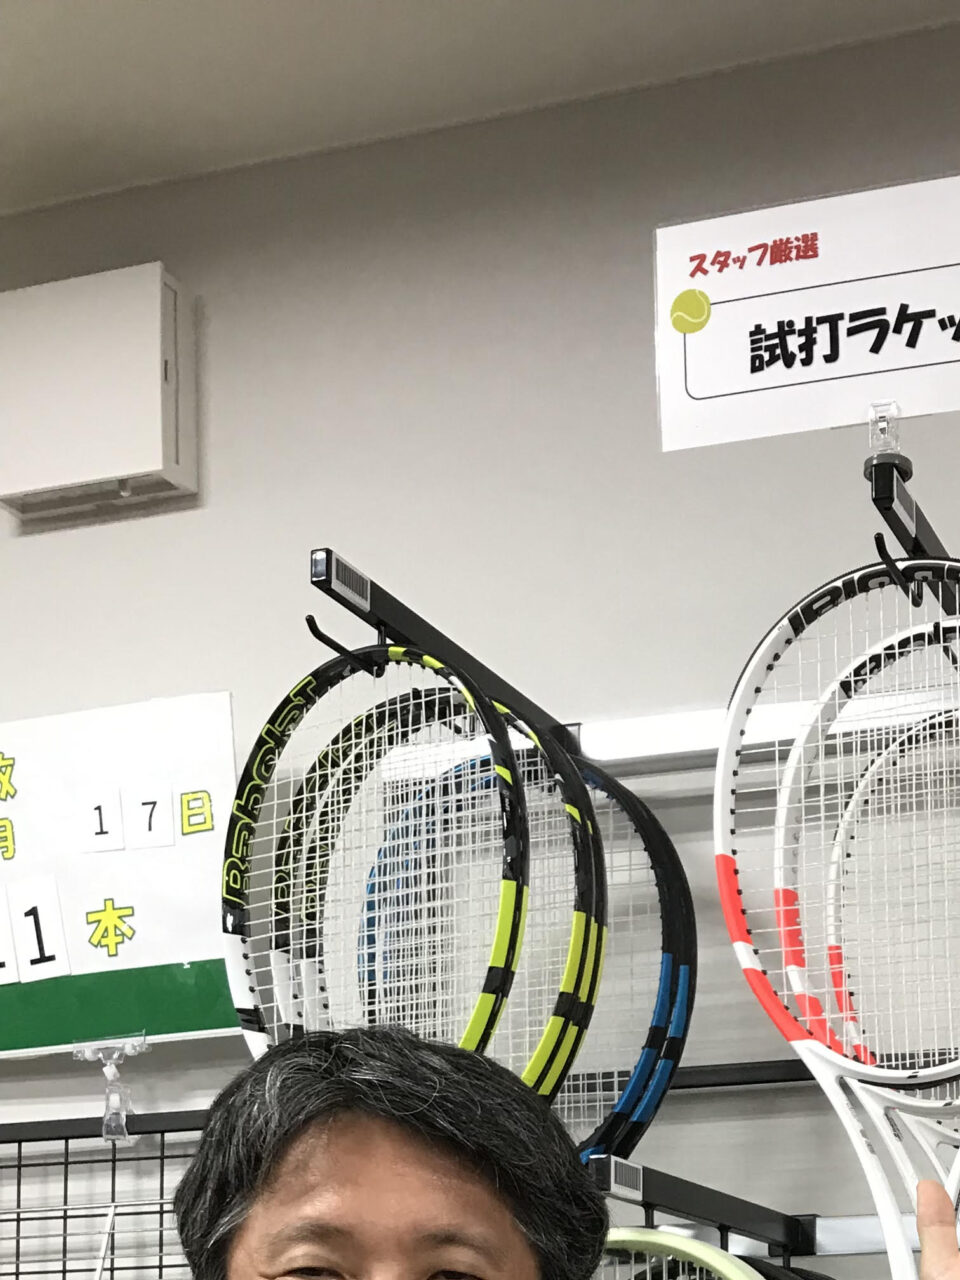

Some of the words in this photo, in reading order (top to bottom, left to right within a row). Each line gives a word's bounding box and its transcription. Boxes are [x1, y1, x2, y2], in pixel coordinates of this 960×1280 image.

[688, 232, 819, 278] スタッフ厳選
